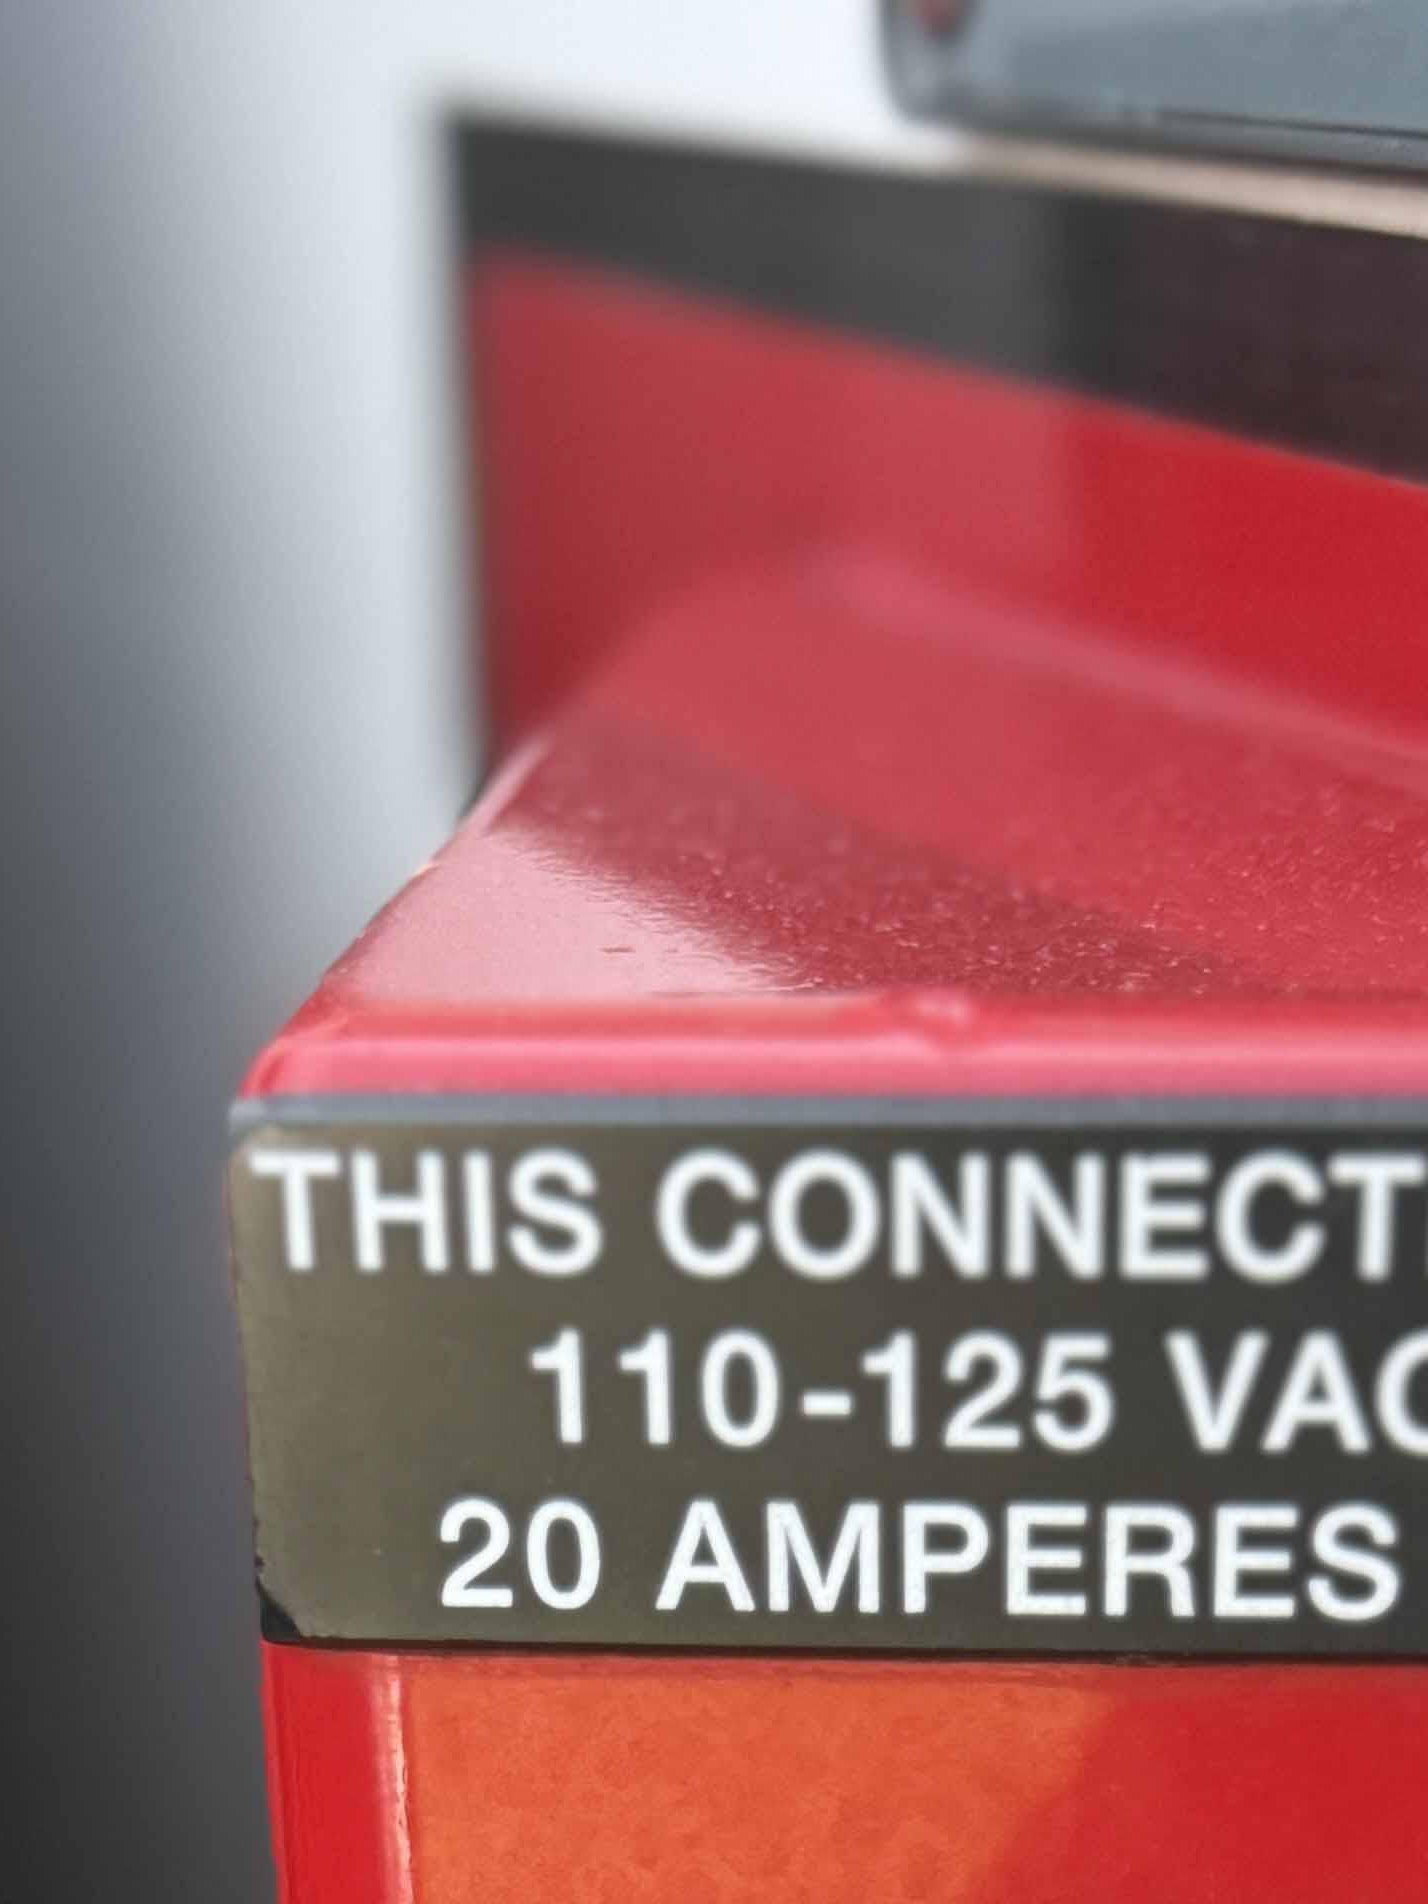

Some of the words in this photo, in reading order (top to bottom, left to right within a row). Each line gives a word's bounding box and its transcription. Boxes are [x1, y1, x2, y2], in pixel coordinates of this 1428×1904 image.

[248, 1145, 606, 1277] THIS
[528, 1326, 1115, 1453] 110-125
[437, 1495, 604, 1612] 20
[653, 1497, 1402, 1623] AMPERES
